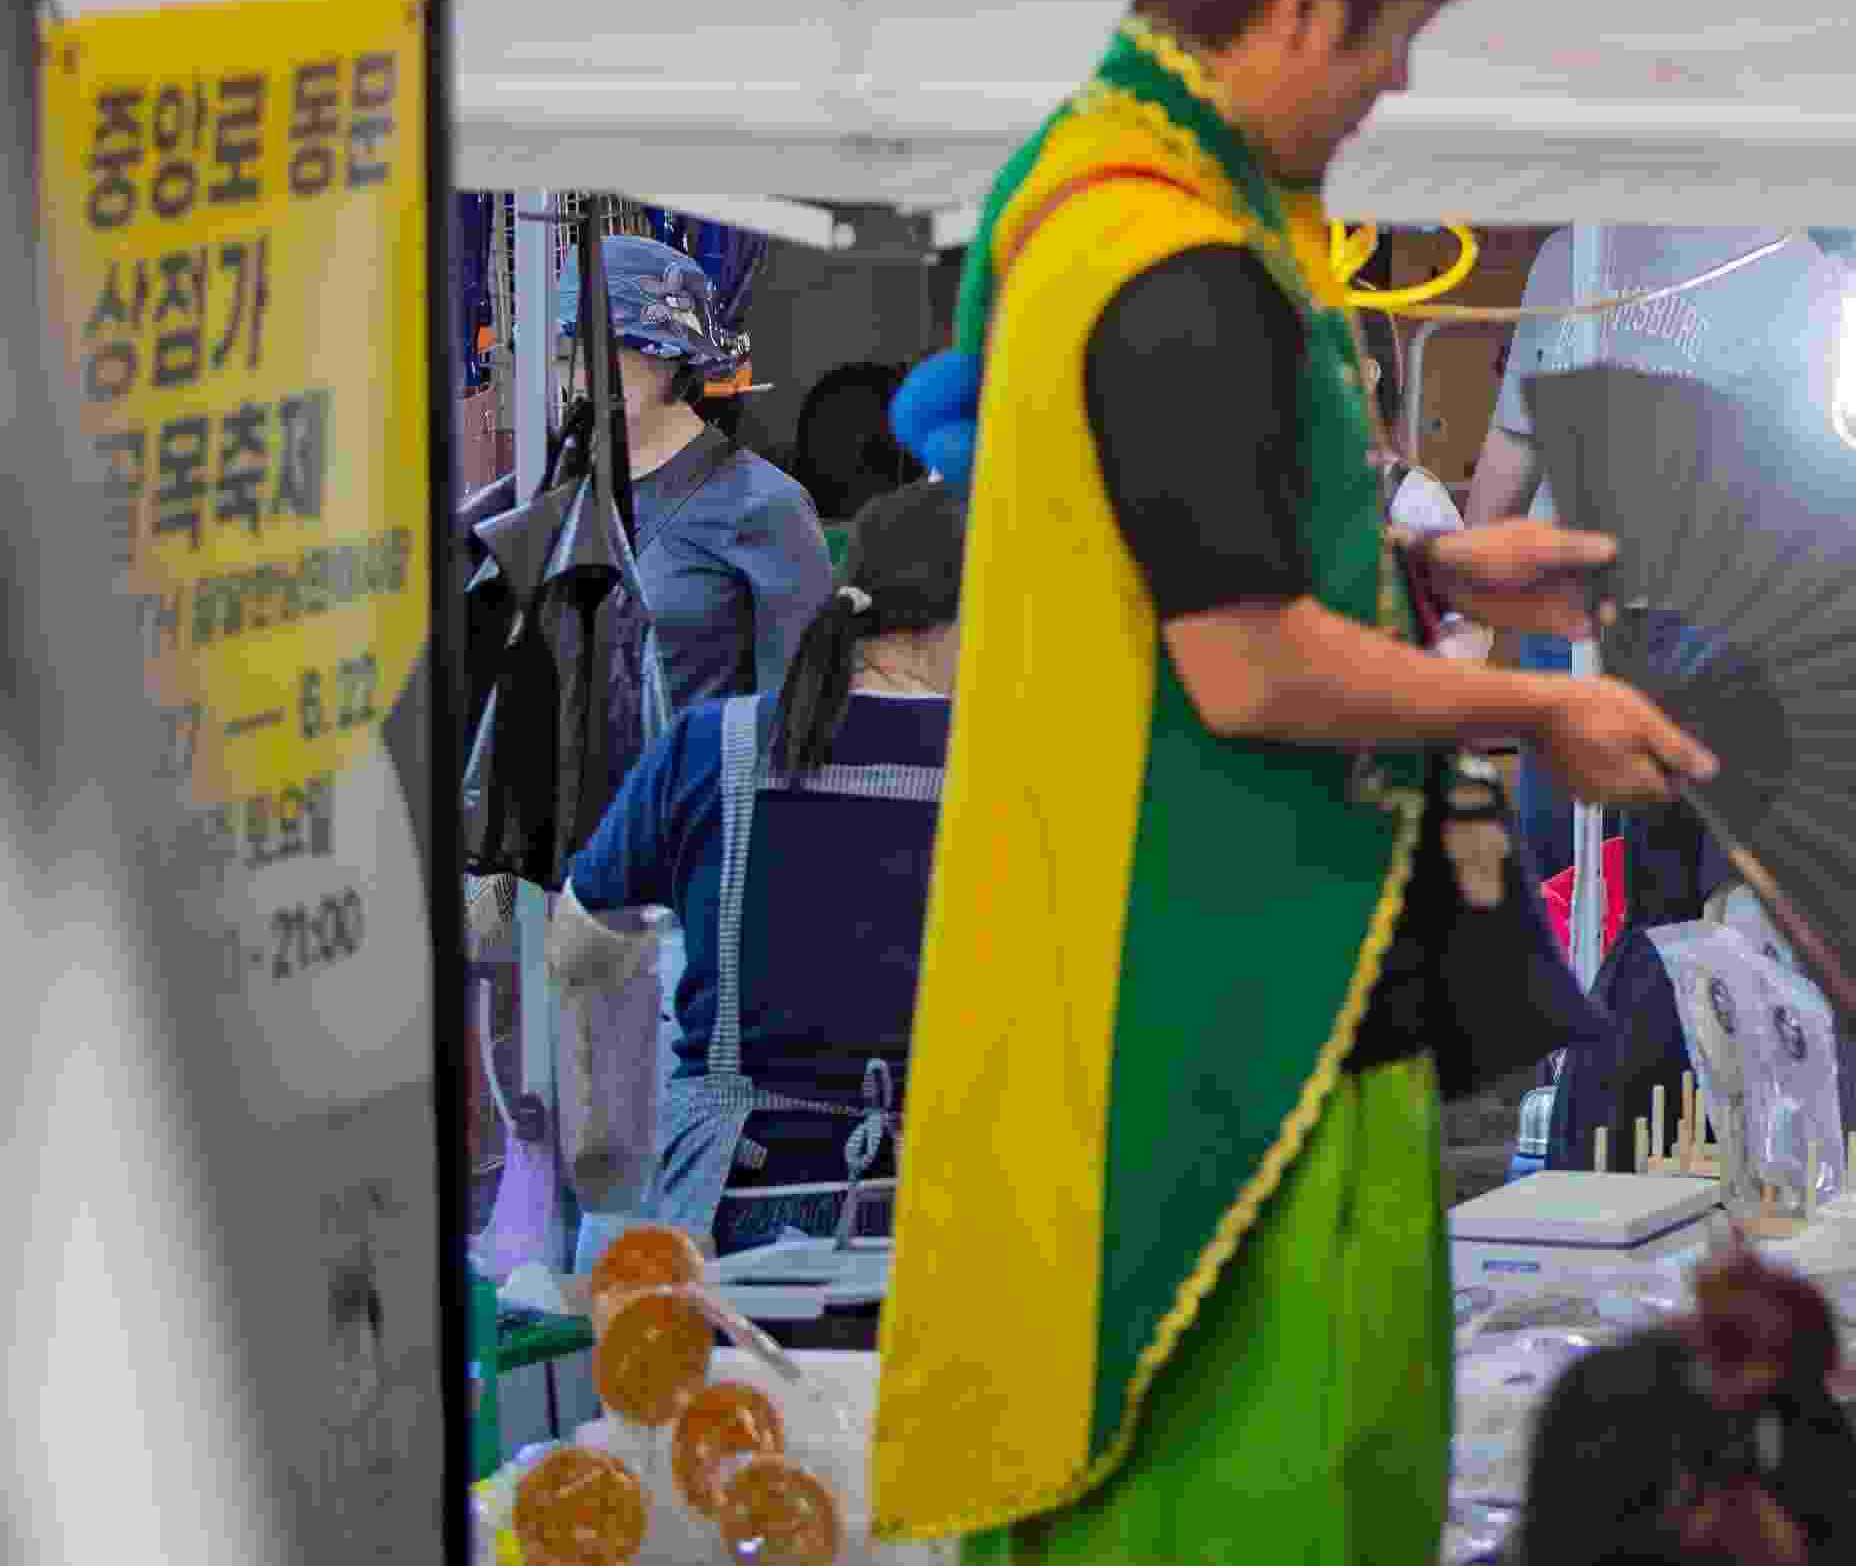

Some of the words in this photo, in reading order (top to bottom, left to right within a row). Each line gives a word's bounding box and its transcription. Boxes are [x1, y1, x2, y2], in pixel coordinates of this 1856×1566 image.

[86, 68, 269, 231] 중앙로
[288, 49, 396, 200] 동문
[82, 233, 270, 403] 상점가
